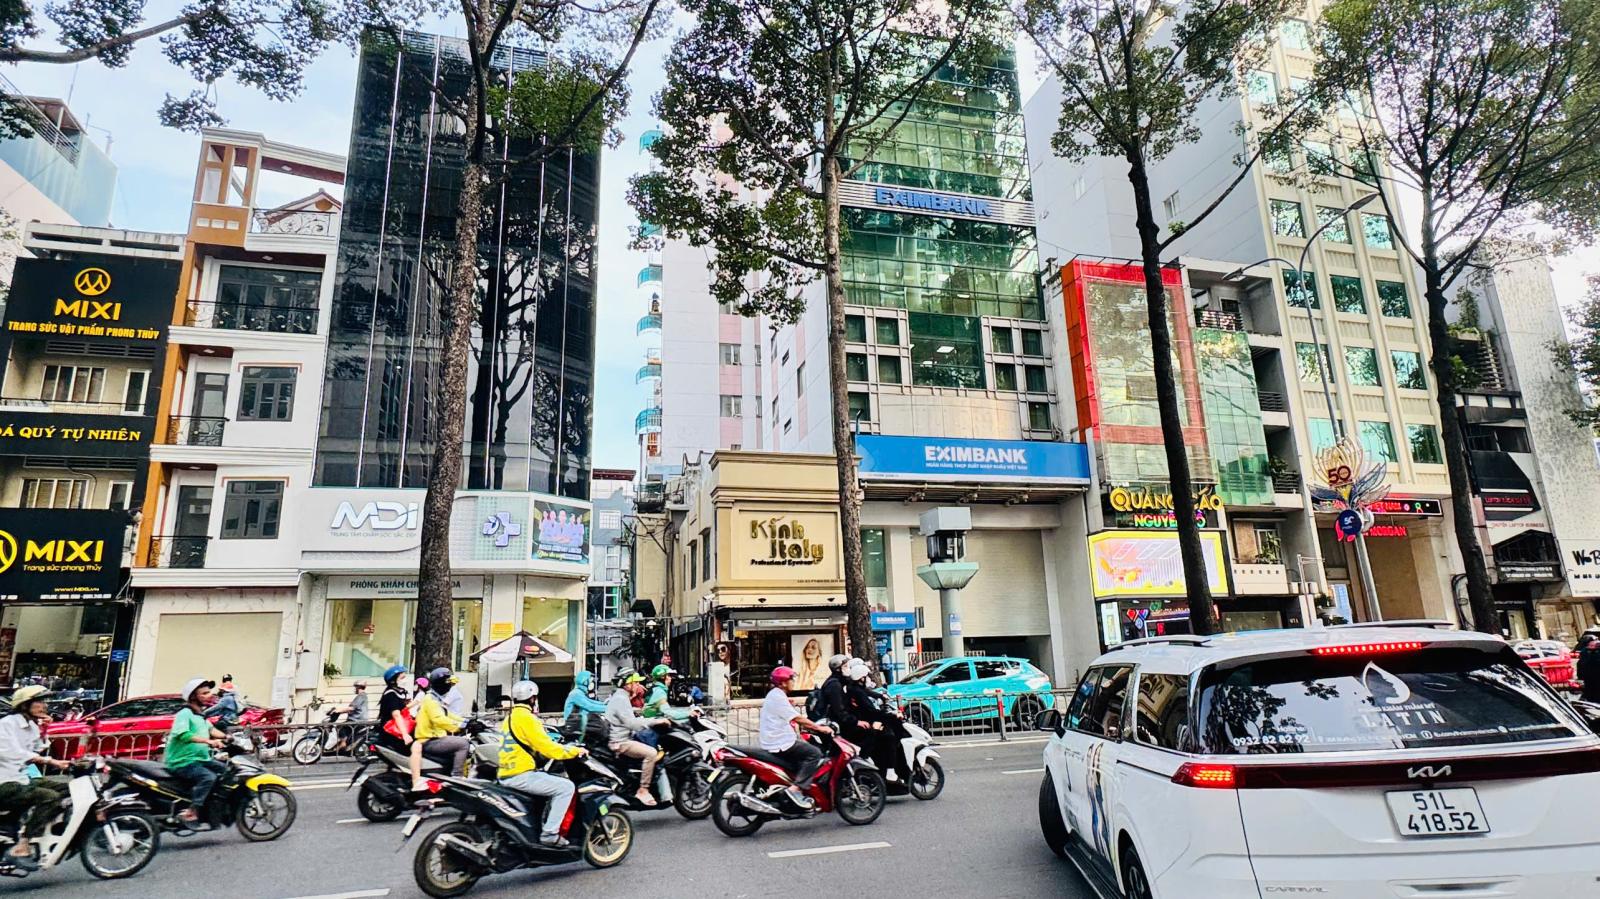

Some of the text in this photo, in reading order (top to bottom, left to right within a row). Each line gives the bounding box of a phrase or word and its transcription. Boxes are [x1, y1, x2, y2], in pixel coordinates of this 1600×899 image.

[875, 187, 992, 217] EXIMBANK
[54, 298, 122, 321] MIXI
[8, 321, 37, 332] TRANG
[39, 321, 57, 333] SỨC
[106, 327, 135, 338] PHONG
[0, 424, 141, 442] Á QUÝ TỰ NHIÊN
[924, 446, 1027, 464] EXIMBANK
[1328, 466, 1352, 484] 50
[331, 501, 419, 531] MDI
[750, 516, 805, 539] Kính
[24, 540, 104, 562] MIXI
[769, 539, 824, 564] Italy
[23, 564, 46, 572] Trang
[60, 564, 85, 572] phong
[350, 579, 379, 589] PHÒNG
[380, 580, 405, 589] KHÁM
[1361, 710, 1447, 728] LATIN
[1233, 733, 1311, 747] 0932 82 82 92
[1412, 791, 1455, 811] 51L
[1408, 811, 1479, 833] 418.52
